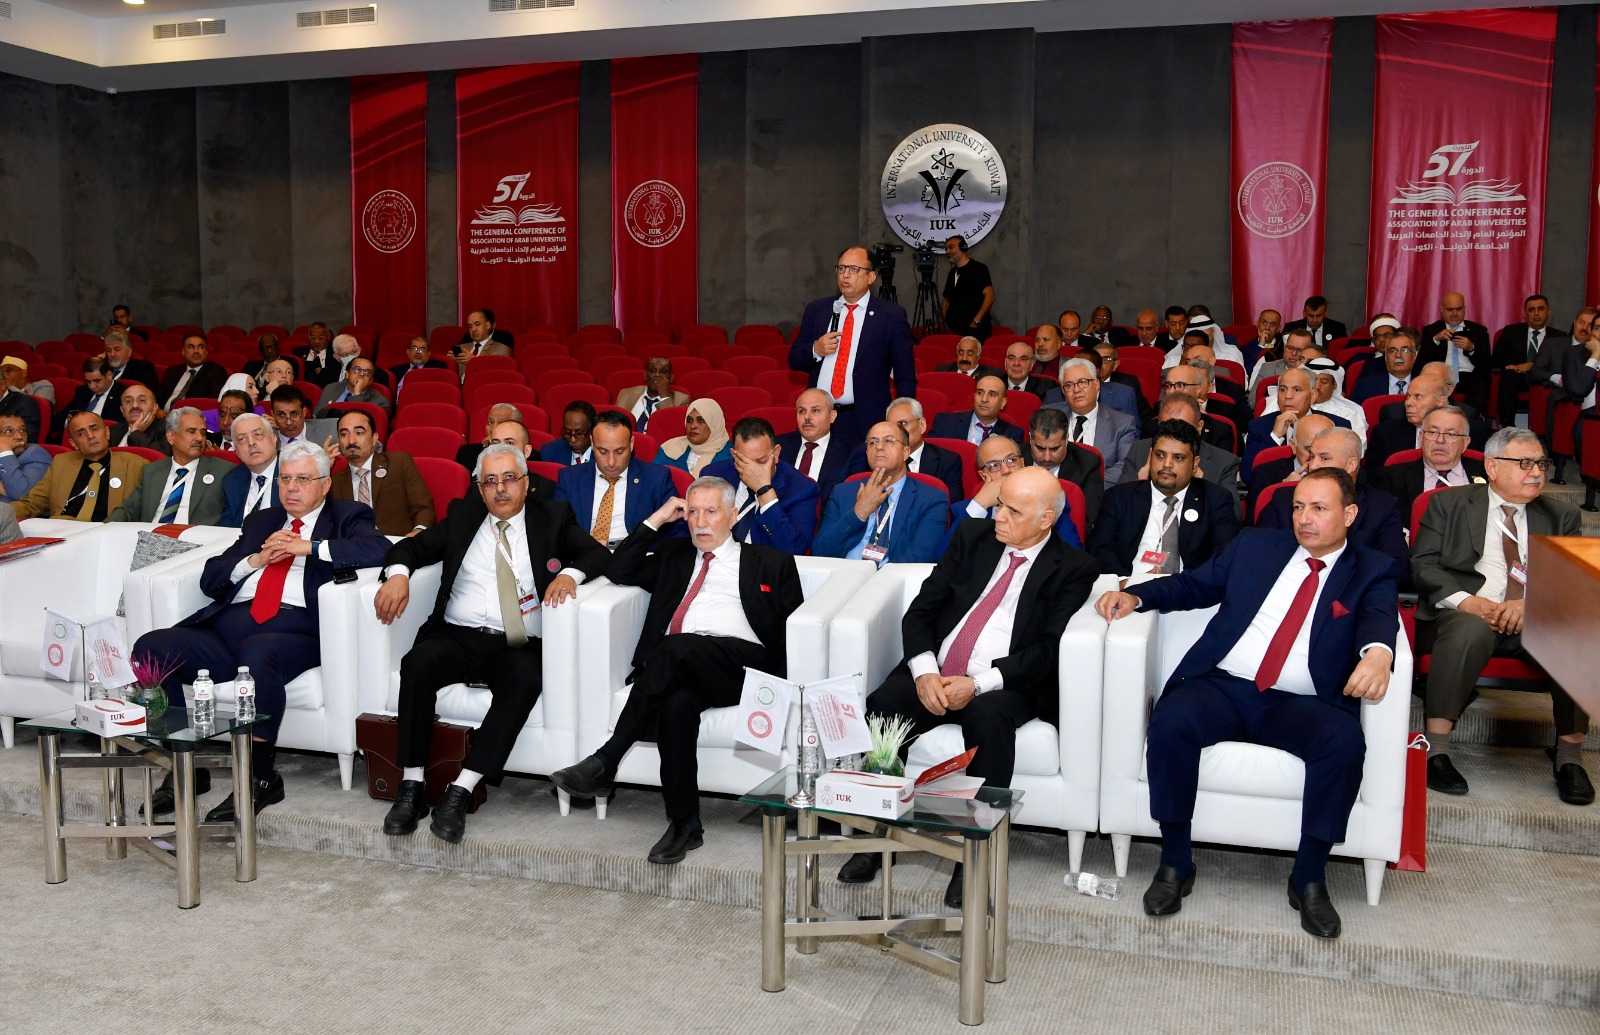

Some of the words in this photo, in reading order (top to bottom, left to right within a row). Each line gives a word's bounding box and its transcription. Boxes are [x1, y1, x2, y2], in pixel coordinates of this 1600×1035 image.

[1423, 140, 1480, 178] 57
[887, 134, 932, 199] INTERNATIONAL
[933, 131, 986, 155] UNIVERSITY
[984, 157, 1000, 196] KUWAIT
[1462, 166, 1484, 175] الدورة
[493, 171, 531, 203] 57
[1242, 168, 1271, 205] INTERNATIONAL
[1272, 166, 1303, 181] UNIVERSITY
[1389, 210, 1405, 218] THE
[1408, 209, 1449, 217] GENERAL
[1451, 208, 1511, 216] CONFERENCE
[1514, 208, 1526, 216] OF
[895, 214, 922, 240] الكويت
[930, 220, 956, 230] IUK
[965, 212, 991, 240] الجامعة
[1388, 232, 1413, 240] العربية
[1416, 231, 1448, 239] الجامعات
[1473, 230, 1494, 239] العام
[1496, 230, 1526, 239] المؤتمر
[836, 794, 852, 802] IUK
